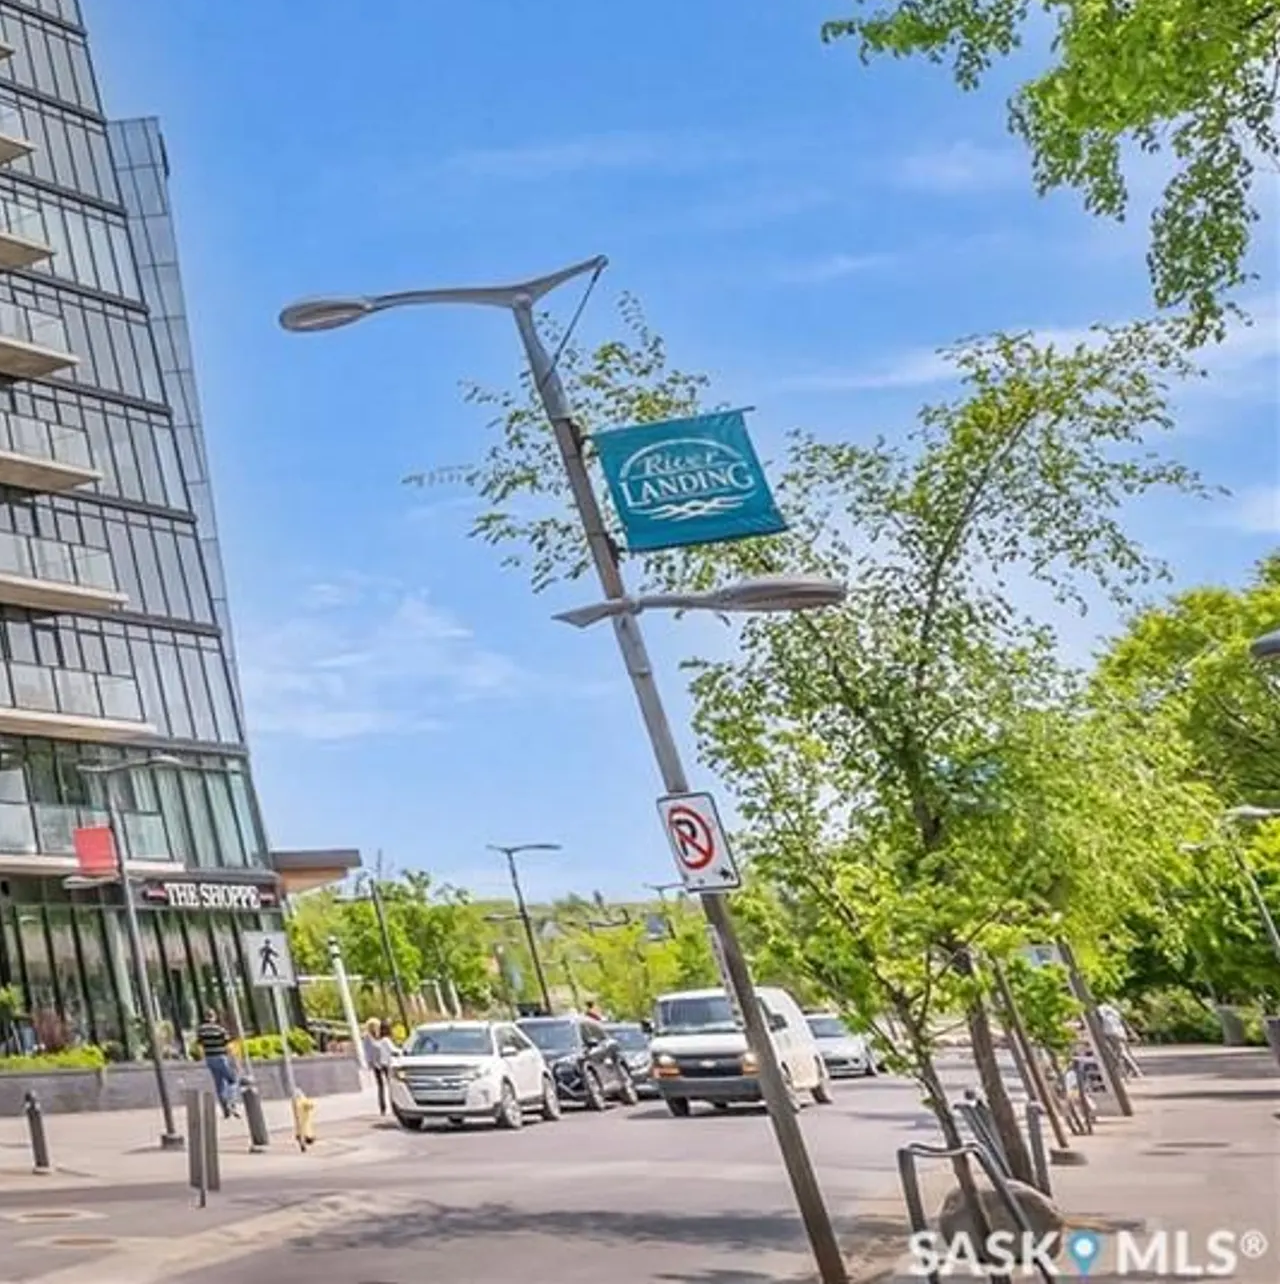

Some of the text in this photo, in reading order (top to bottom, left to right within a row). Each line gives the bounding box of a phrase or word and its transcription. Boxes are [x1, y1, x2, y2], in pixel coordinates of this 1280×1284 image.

[620, 462, 754, 507] LANDING
[164, 883, 261, 908] THE SHOPPE
